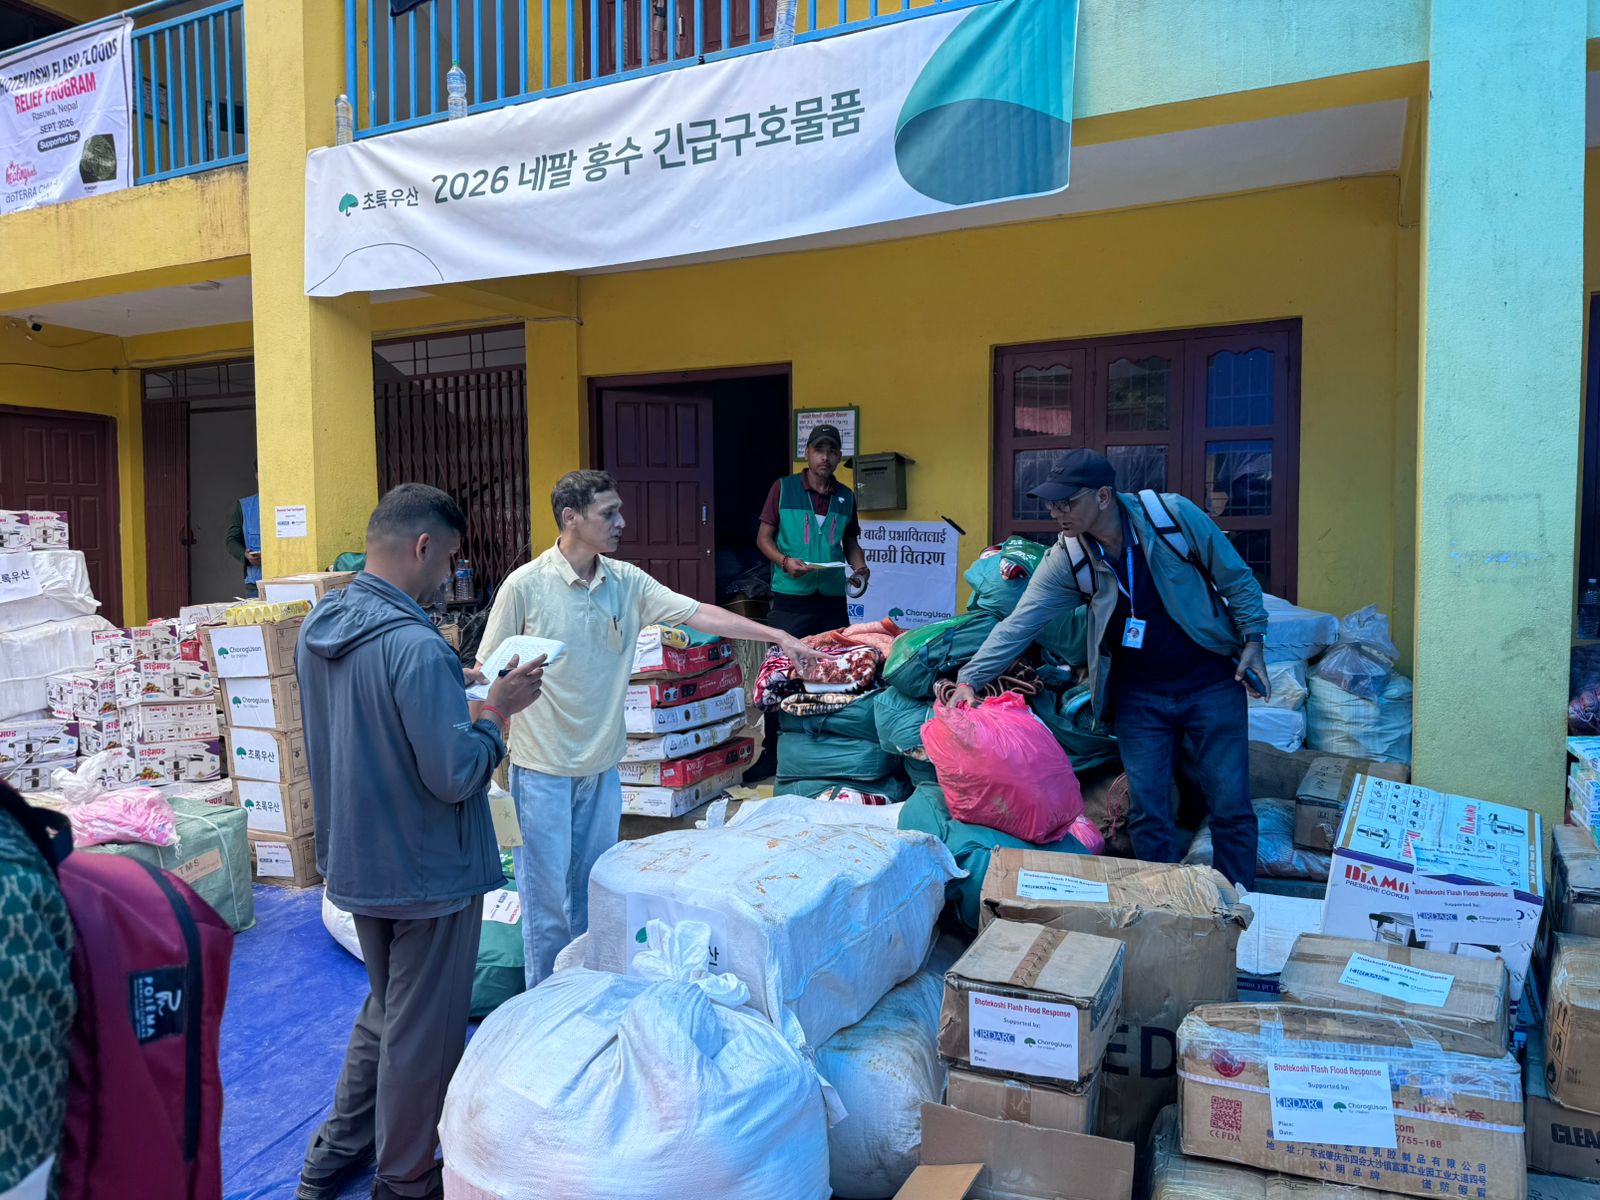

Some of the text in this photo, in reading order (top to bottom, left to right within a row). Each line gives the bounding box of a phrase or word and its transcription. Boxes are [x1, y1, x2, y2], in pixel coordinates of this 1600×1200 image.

[15, 71, 97, 115] RELIEF PROGRAM
[58, 101, 78, 113] Nepal
[40, 118, 74, 134] SEPT 2026
[40, 137, 69, 150] Supported
[431, 89, 865, 204] 2026 네팔 홍수 긴급구호물품
[361, 186, 419, 212] 초록우산
[864, 525, 947, 544] बाढी प्रभावितलाई
[900, 545, 946, 566] वितरण
[0, 568, 31, 584] 록우산
[248, 749, 275, 763] 초록우산
[255, 800, 280, 813] 초록우산
[1345, 880, 1410, 901] PRESSURE COOKER
[1415, 888, 1446, 897] Bhotekoshi
[1447, 889, 1462, 897] Flash
[1480, 891, 1509, 899] Response
[144, 976, 156, 1037] POIEMA
[974, 997, 1072, 1018] Bhotekoshi Flash Flood Response
[1003, 1017, 1032, 1028] Supported
[1037, 1039, 1073, 1049] ChorogUsan
[1273, 1062, 1382, 1077] Bhotekoshi Flash Flood Response
[1307, 1081, 1350, 1091] Supported by:
[1275, 1096, 1388, 1112] KIRDARC ChorogUsan
[1221, 1130, 1241, 1143] FDA
